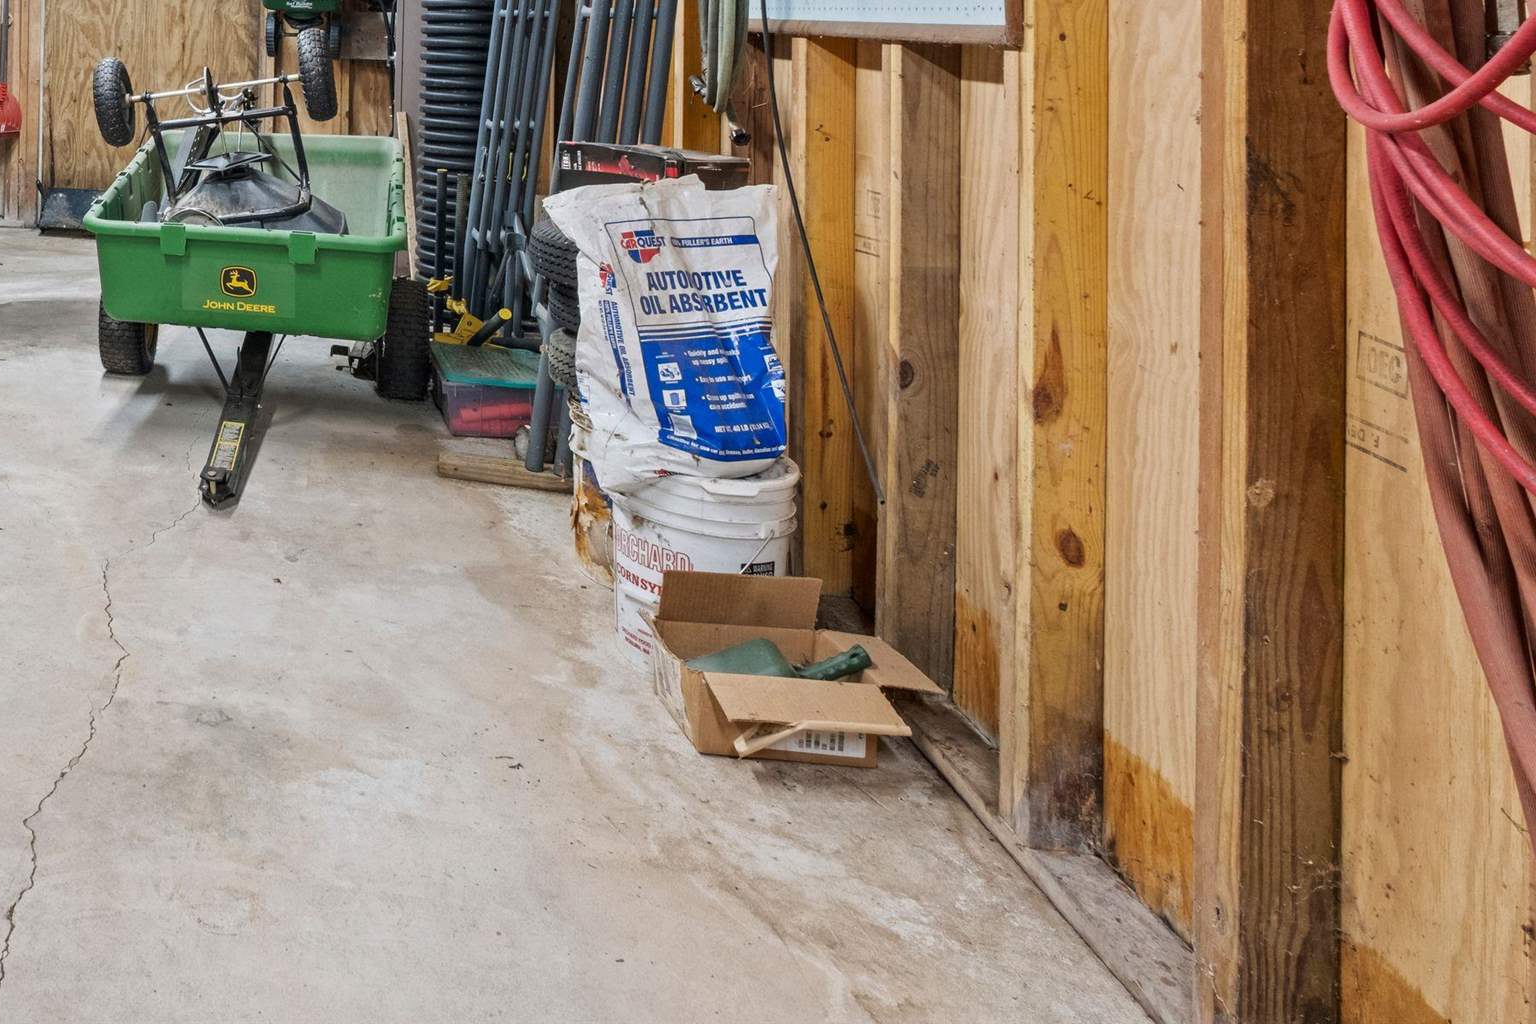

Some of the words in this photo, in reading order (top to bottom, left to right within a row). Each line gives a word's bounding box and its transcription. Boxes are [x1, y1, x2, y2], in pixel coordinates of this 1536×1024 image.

[620, 235, 666, 250] CARQUEST
[681, 238, 710, 248] FULLER'S
[711, 236, 733, 246] EARTH
[203, 299, 234, 311] JOHN
[236, 301, 276, 314] DEERE
[640, 295, 667, 315] OIL
[669, 288, 768, 314] ABSRBENT
[617, 562, 640, 588] CORN
